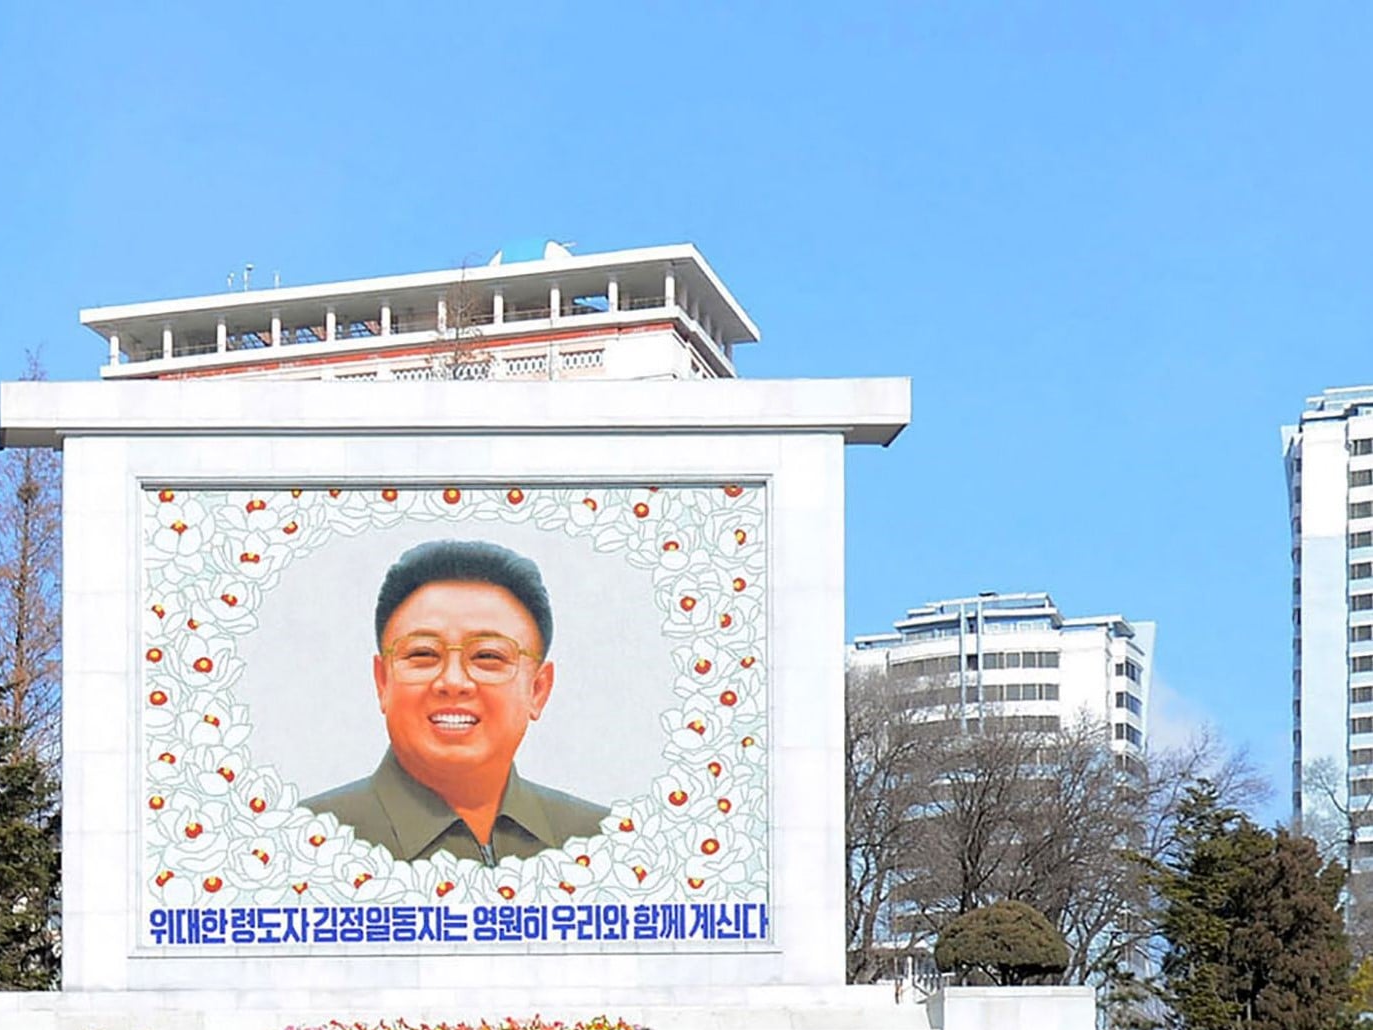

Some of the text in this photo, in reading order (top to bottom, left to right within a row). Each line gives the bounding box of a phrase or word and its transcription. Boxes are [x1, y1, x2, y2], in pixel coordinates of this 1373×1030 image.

[149, 903, 769, 945] 위대한 령도자 김정일동지는 영원히 우리와 함께 계신다
